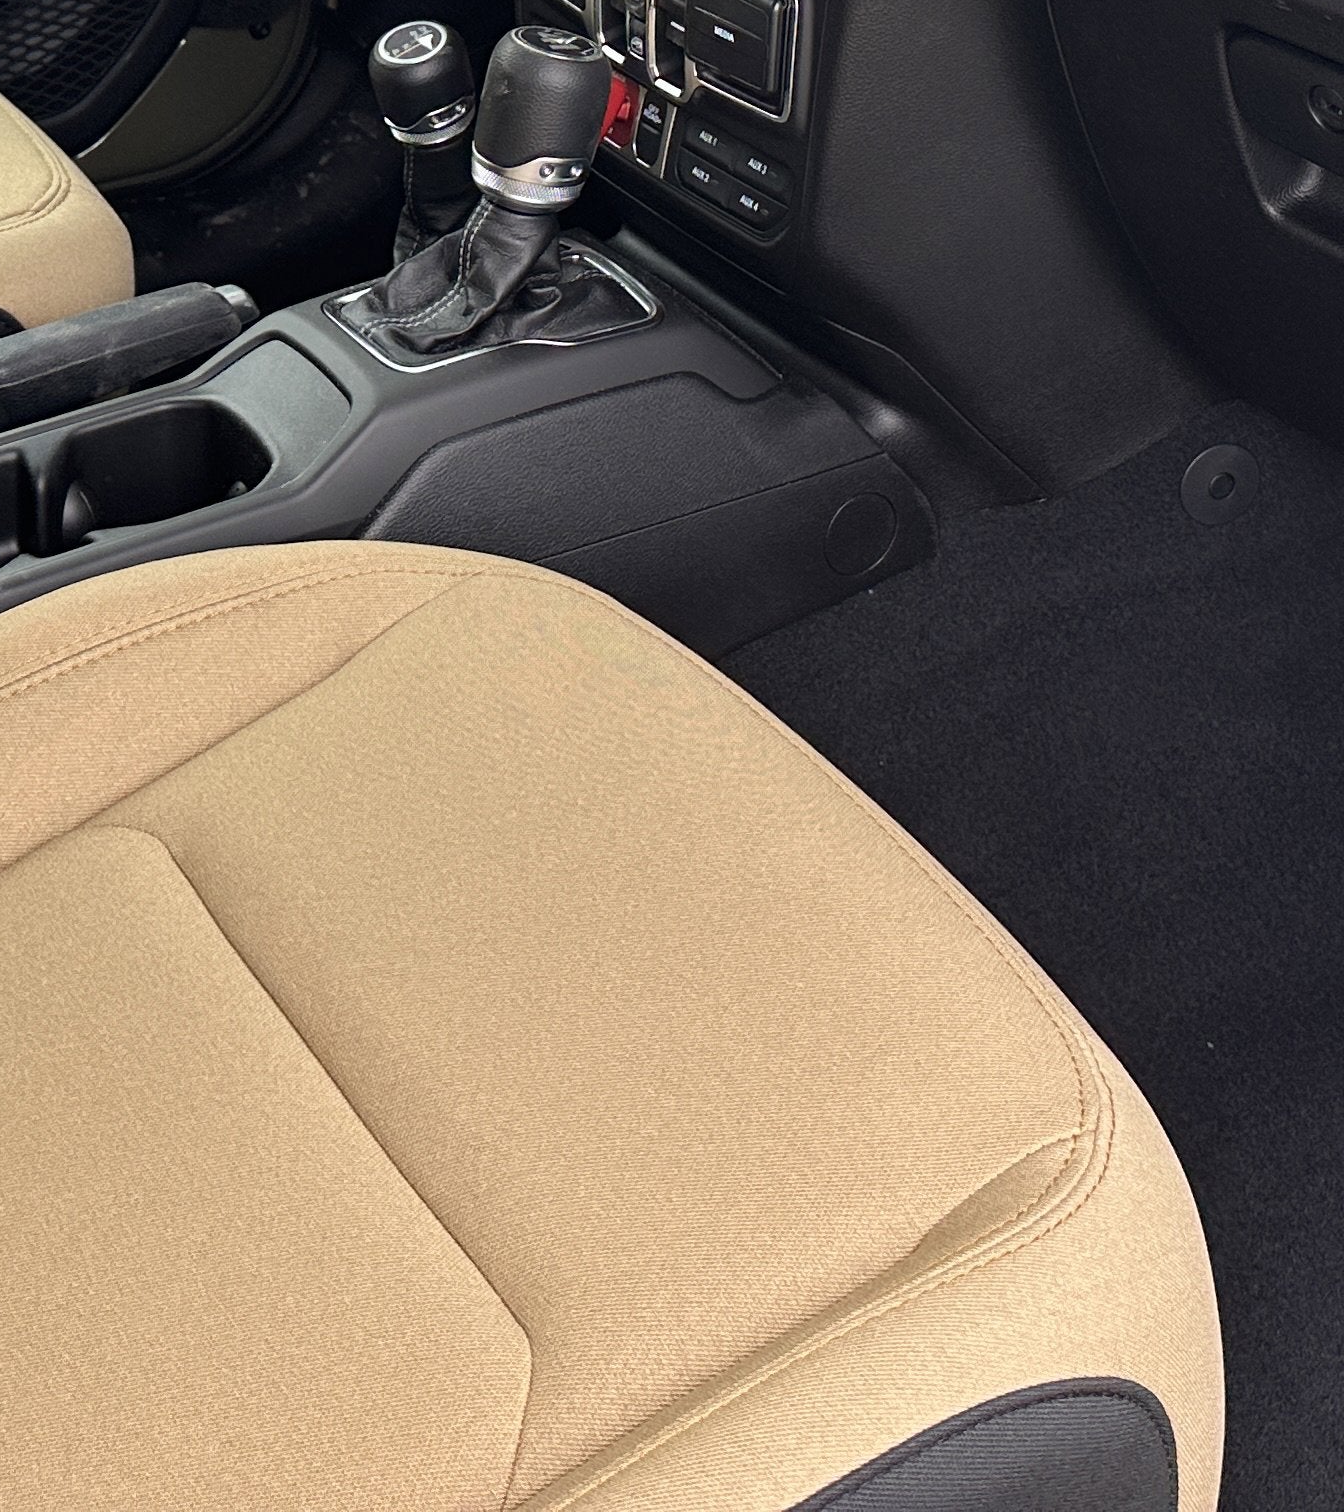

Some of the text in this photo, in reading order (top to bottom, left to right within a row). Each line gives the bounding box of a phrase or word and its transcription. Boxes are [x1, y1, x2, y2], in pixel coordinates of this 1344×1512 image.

[748, 158, 763, 172] AUX
[692, 166, 705, 181] AUX
[739, 194, 754, 209] AUX
